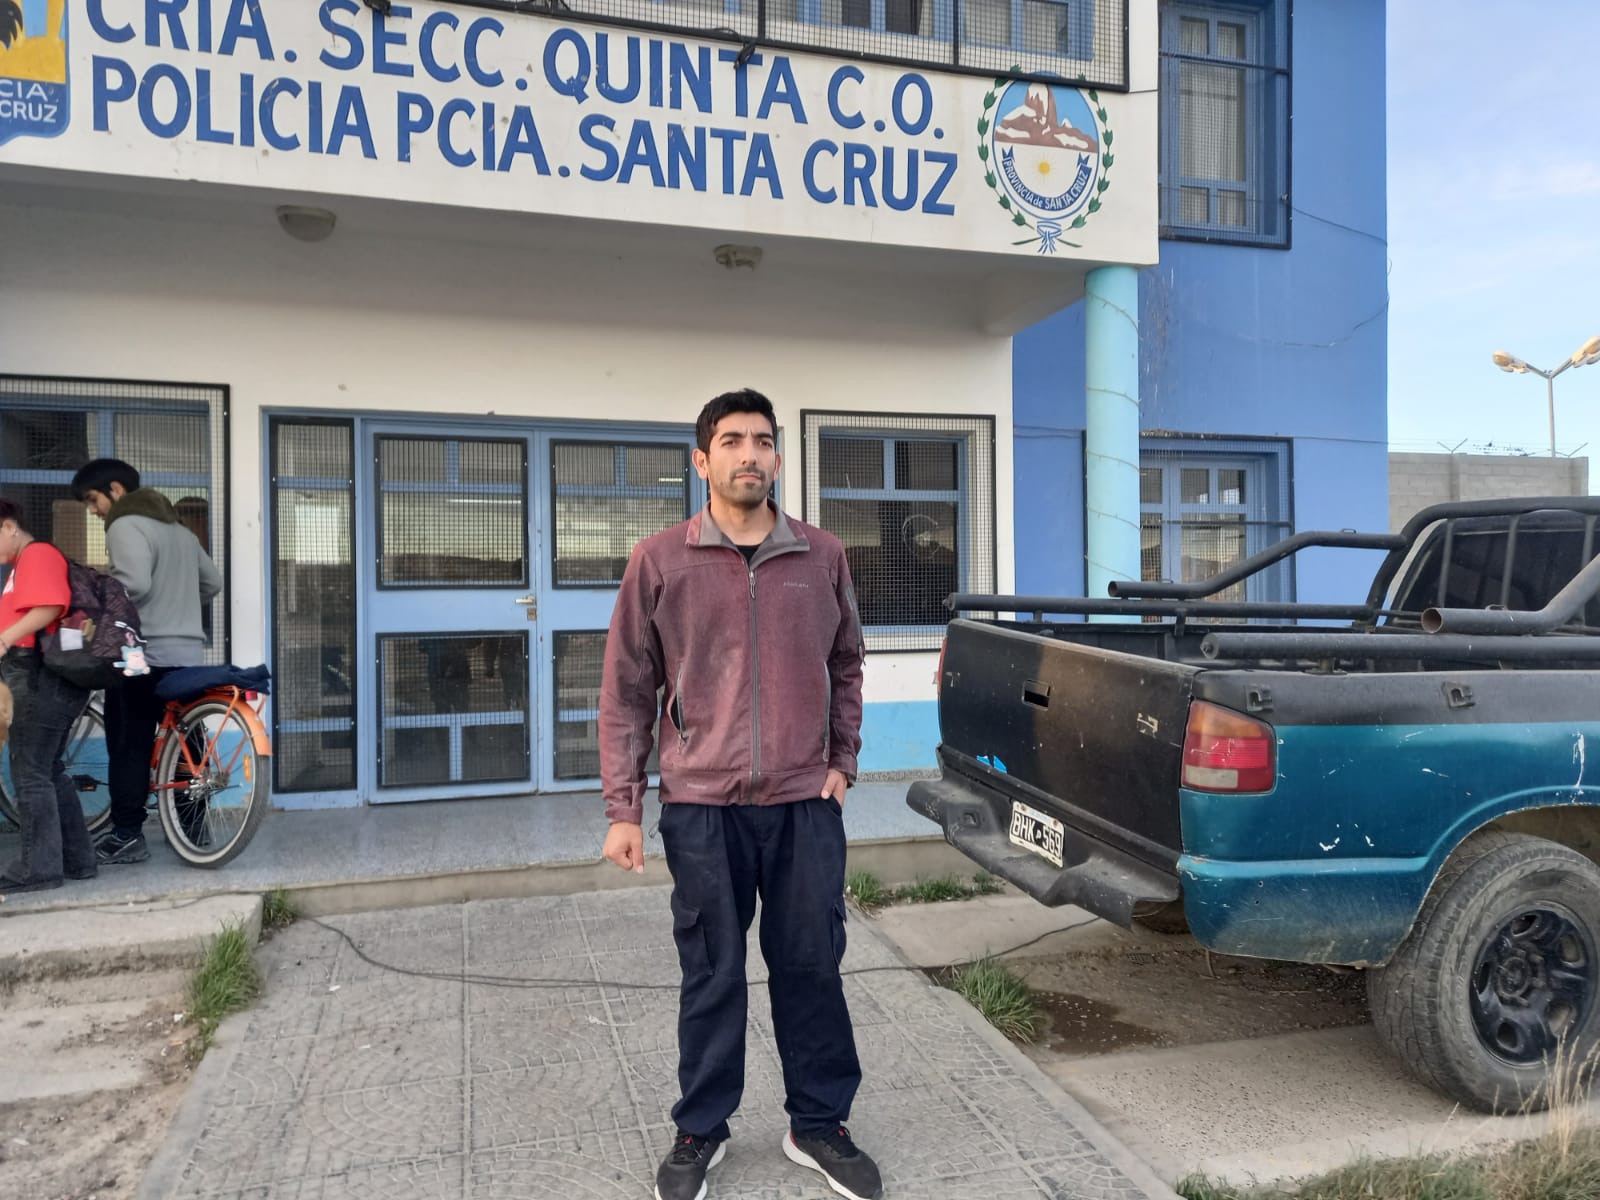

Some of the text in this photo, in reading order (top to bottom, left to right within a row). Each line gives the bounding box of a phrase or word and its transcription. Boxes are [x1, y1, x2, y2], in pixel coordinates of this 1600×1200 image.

[320, 0, 528, 90] SECC.
[544, 28, 807, 123] QUINTA
[0, 100, 57, 123] CRUZ
[92, 56, 377, 159] POLICIA
[803, 140, 958, 215] CRUZ
[1003, 160, 1089, 209] PROVINCIA de SANTA CRUZ
